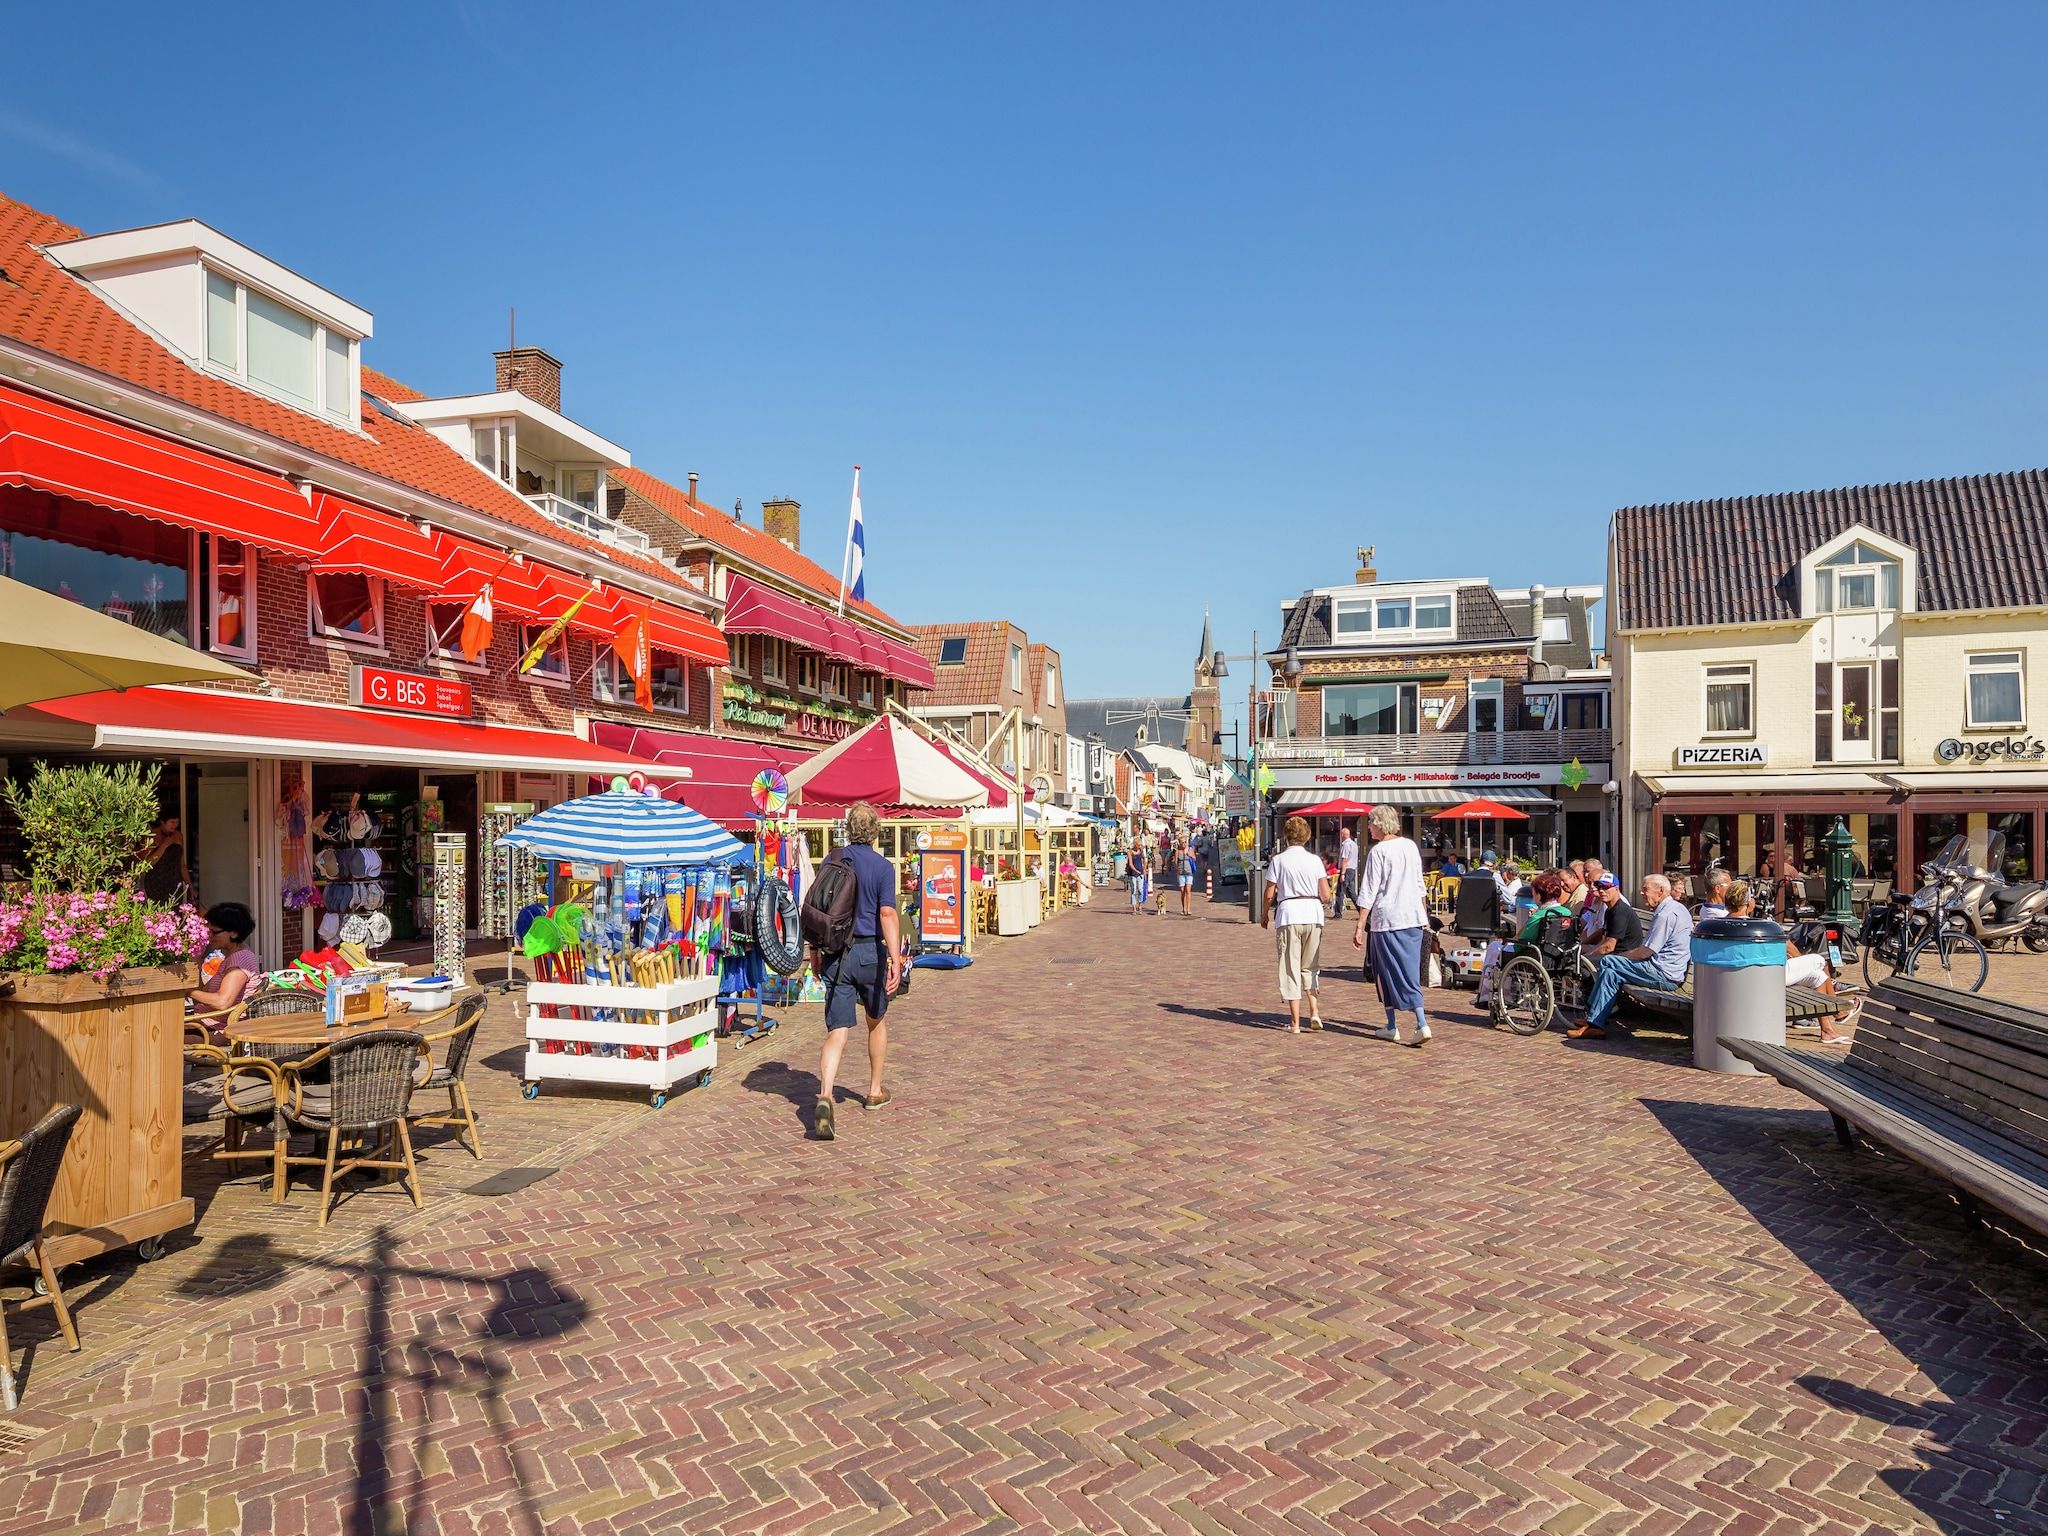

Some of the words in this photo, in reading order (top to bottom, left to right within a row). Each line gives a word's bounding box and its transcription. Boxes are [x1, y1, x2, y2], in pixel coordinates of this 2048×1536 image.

[371, 676, 392, 701] G.
[397, 679, 426, 705] BES
[436, 684, 461, 695] Souvenirs
[436, 700, 464, 711] Speelgoed
[723, 699, 786, 729] Restaurant
[802, 713, 819, 733] DE
[821, 717, 852, 739] KLOK
[1315, 774, 1338, 782] Frites
[1344, 773, 1373, 782] Snacks
[1380, 773, 1406, 783] Softijs
[1413, 772, 1459, 781] Milkshakes
[1467, 772, 1501, 781] Belegde
[1502, 771, 1541, 781] Broodjes
[1226, 784, 1243, 792] Stop!
[930, 908, 943, 916] Met
